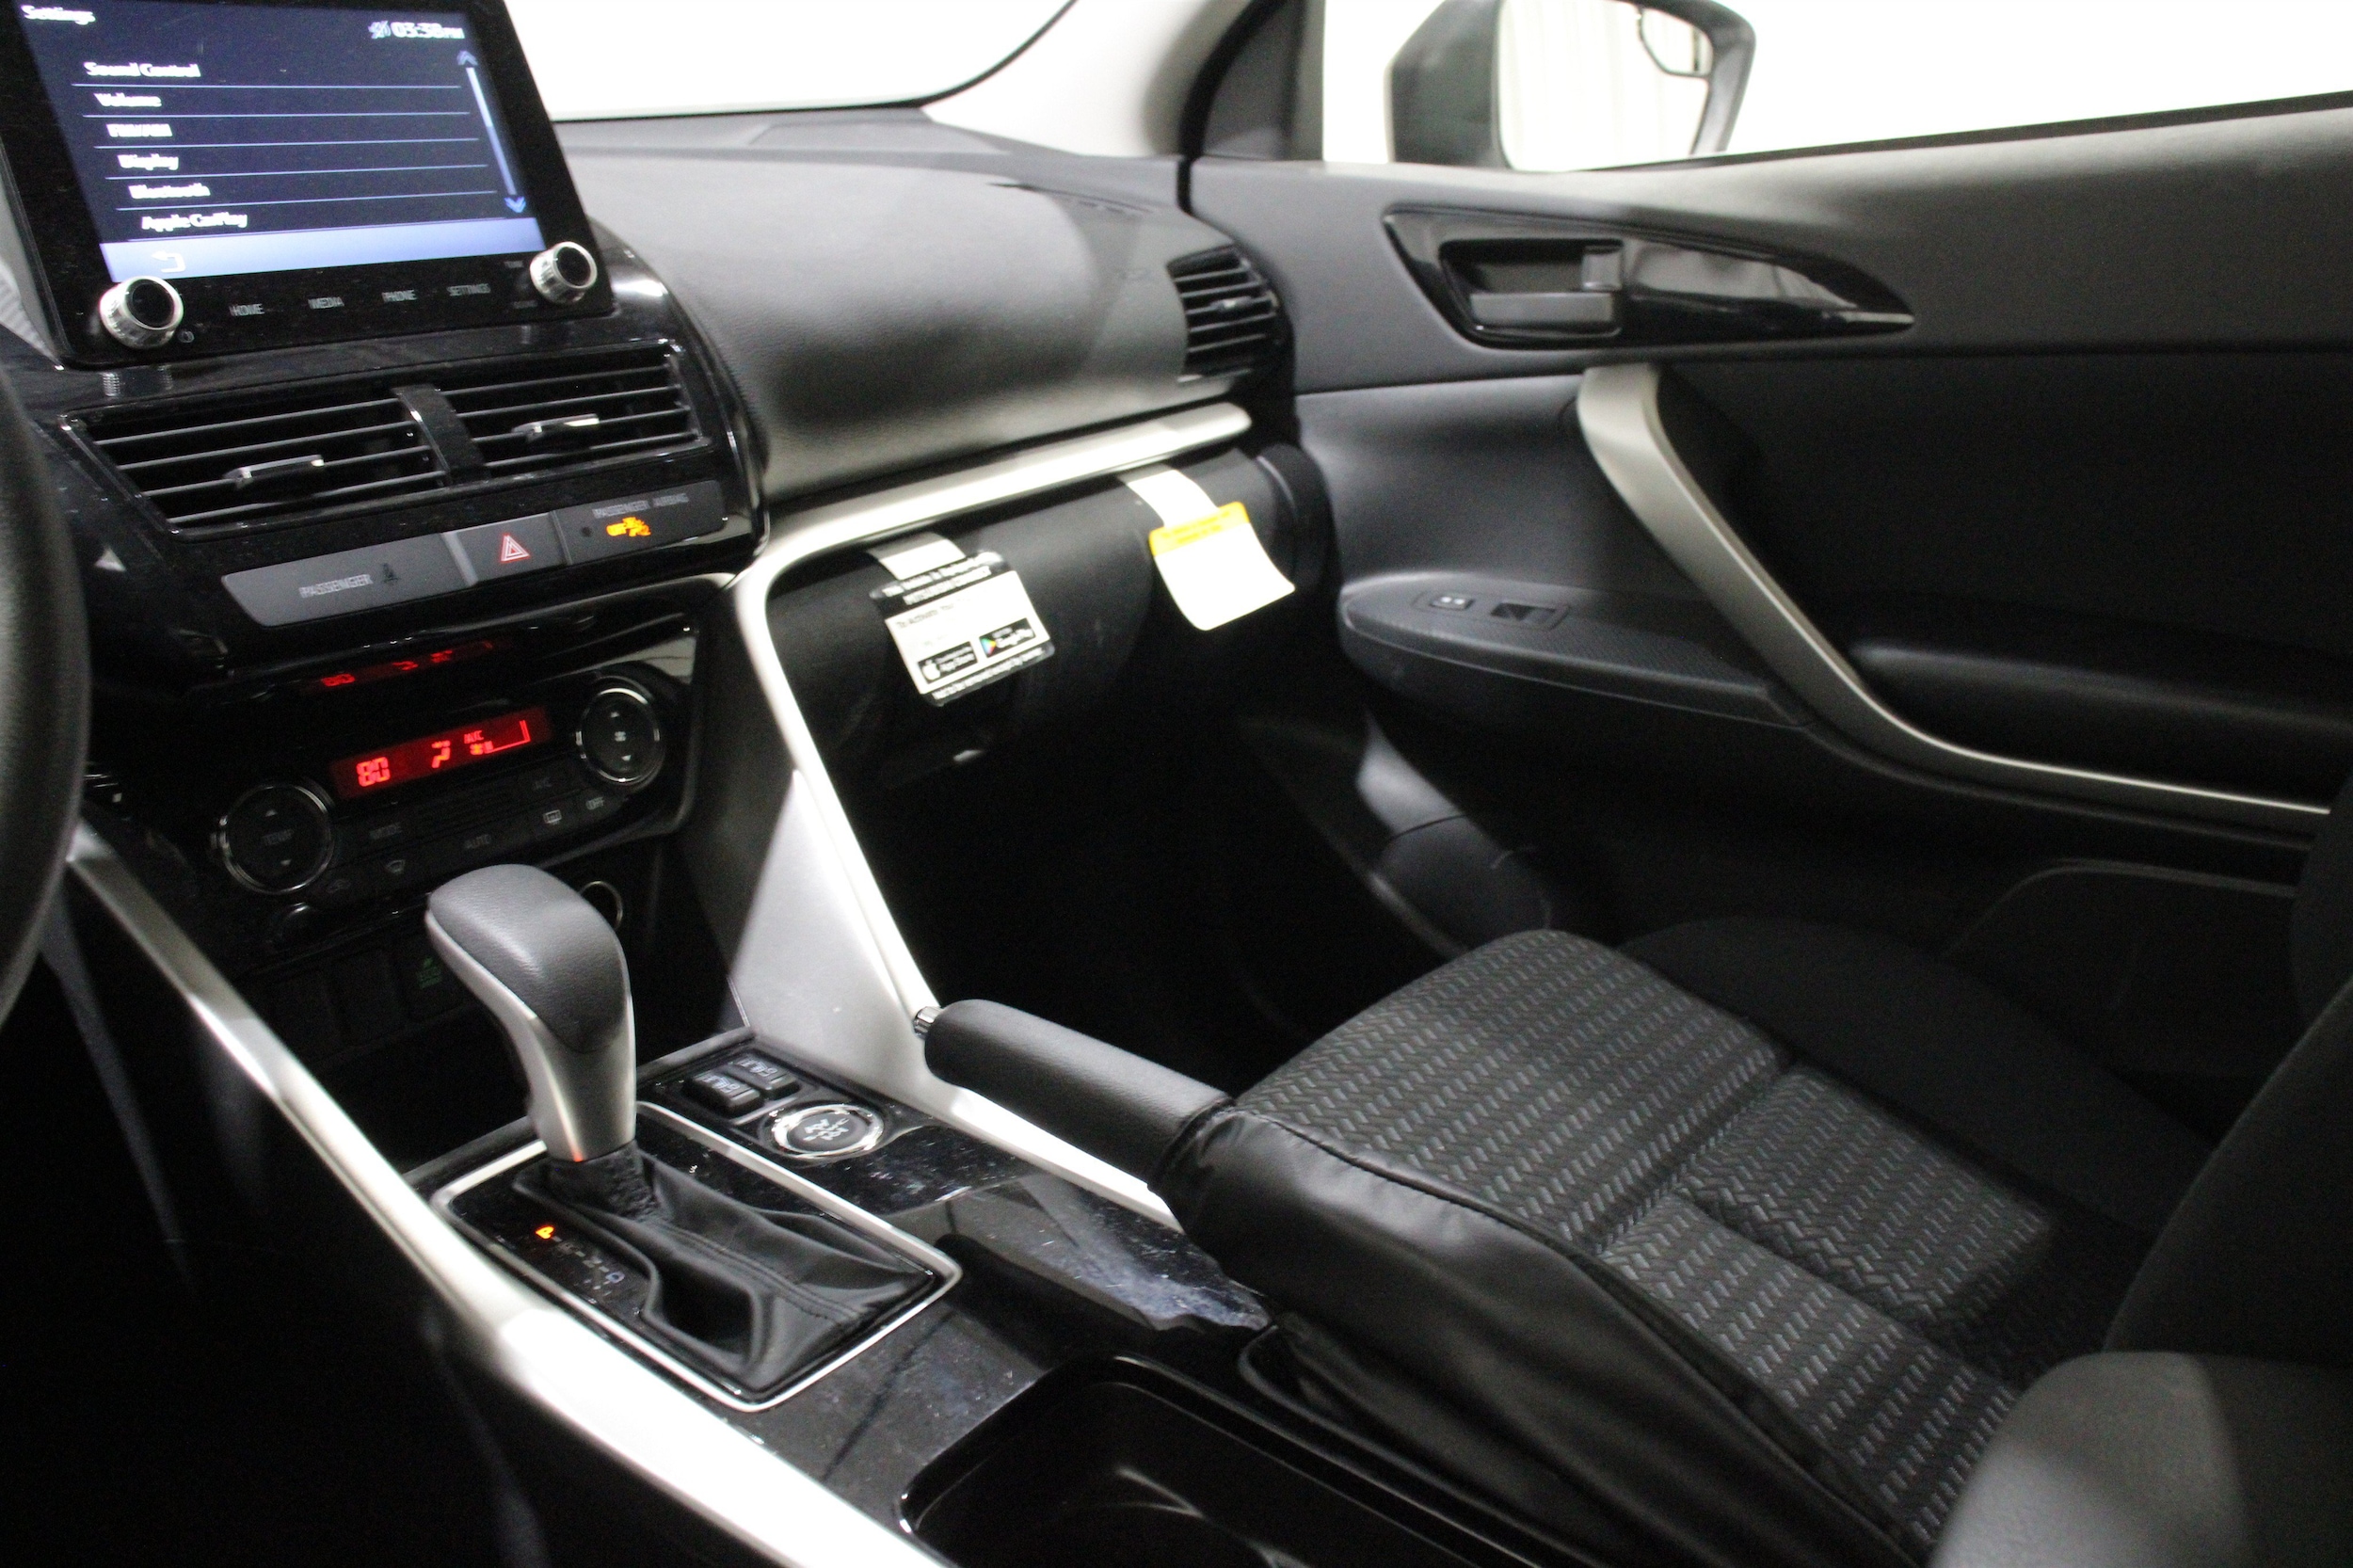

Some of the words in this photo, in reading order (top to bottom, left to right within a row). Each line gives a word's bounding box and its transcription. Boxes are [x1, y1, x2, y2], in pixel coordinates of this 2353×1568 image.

[83, 61, 141, 76] Sound
[139, 63, 201, 77] Control
[94, 92, 162, 107] Volume
[308, 296, 344, 310] MEDIA
[381, 289, 418, 303] PHONE
[229, 303, 264, 316] HOME
[299, 574, 374, 598] PASSENGER
[356, 756, 391, 787] 80
